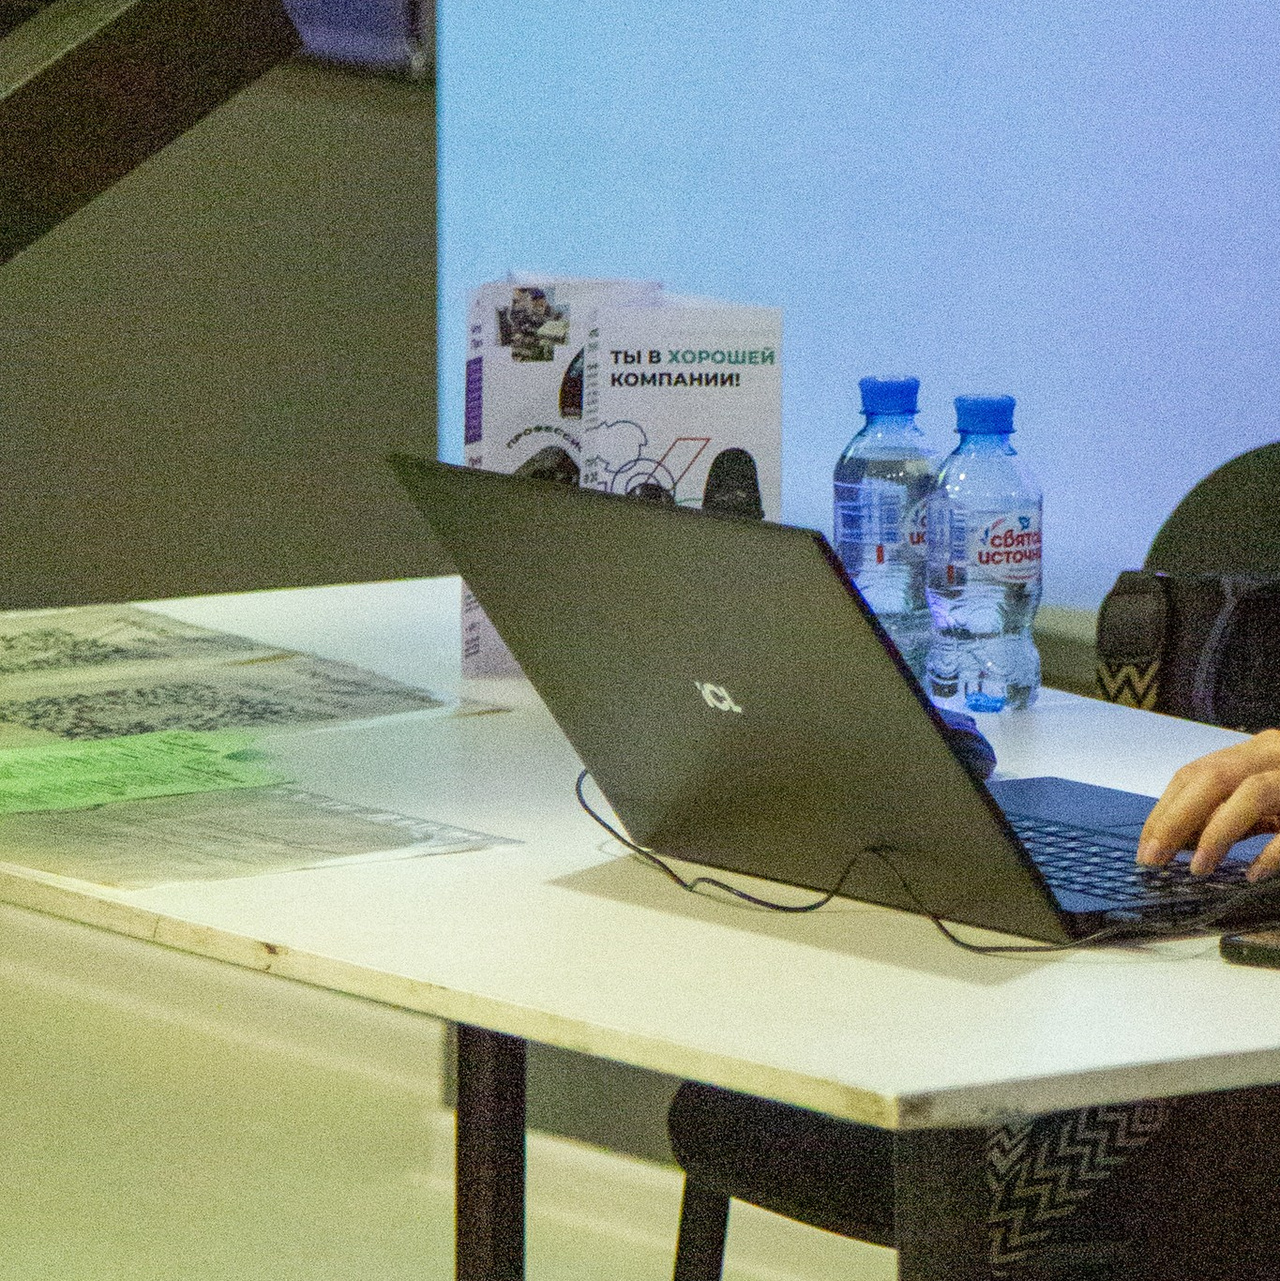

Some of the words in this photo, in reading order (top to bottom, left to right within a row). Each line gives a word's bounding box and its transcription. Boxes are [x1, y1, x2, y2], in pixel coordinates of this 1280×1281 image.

[610, 350, 642, 365] ТЫ
[647, 350, 662, 365] В
[667, 347, 776, 365] ХОРОШЕЙ
[610, 372, 741, 388] КОМПАНИИ!
